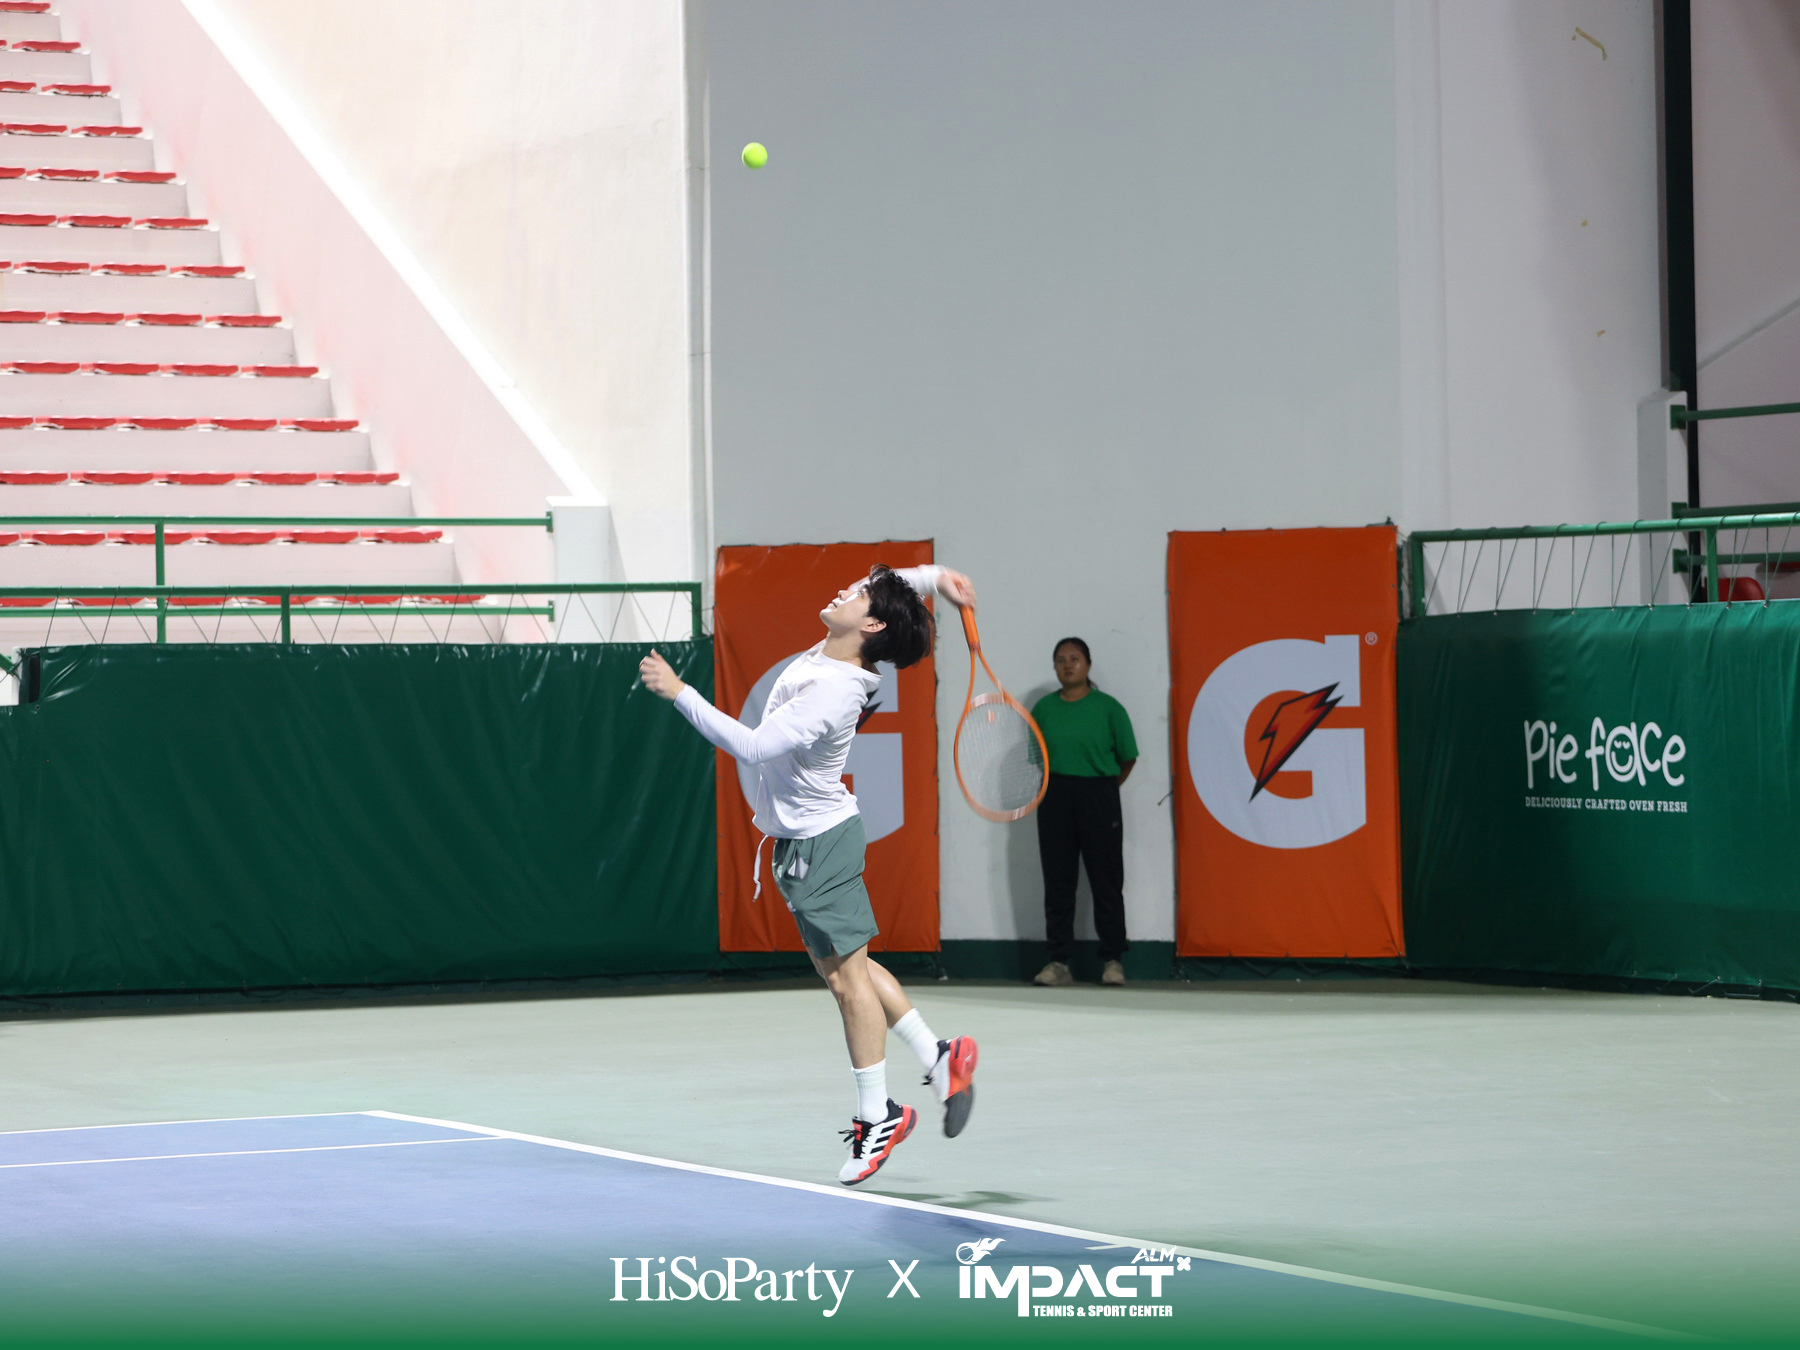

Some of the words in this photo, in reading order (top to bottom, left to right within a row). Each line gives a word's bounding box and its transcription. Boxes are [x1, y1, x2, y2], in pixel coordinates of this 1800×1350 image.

[1187, 634, 1367, 849] G
[1585, 716, 1686, 791] face
[1525, 796, 1582, 809] DELICIOUSLY
[1585, 798, 1627, 811] CRAFTED
[1629, 800, 1656, 812] OVEN
[1657, 801, 1688, 813] FRESH
